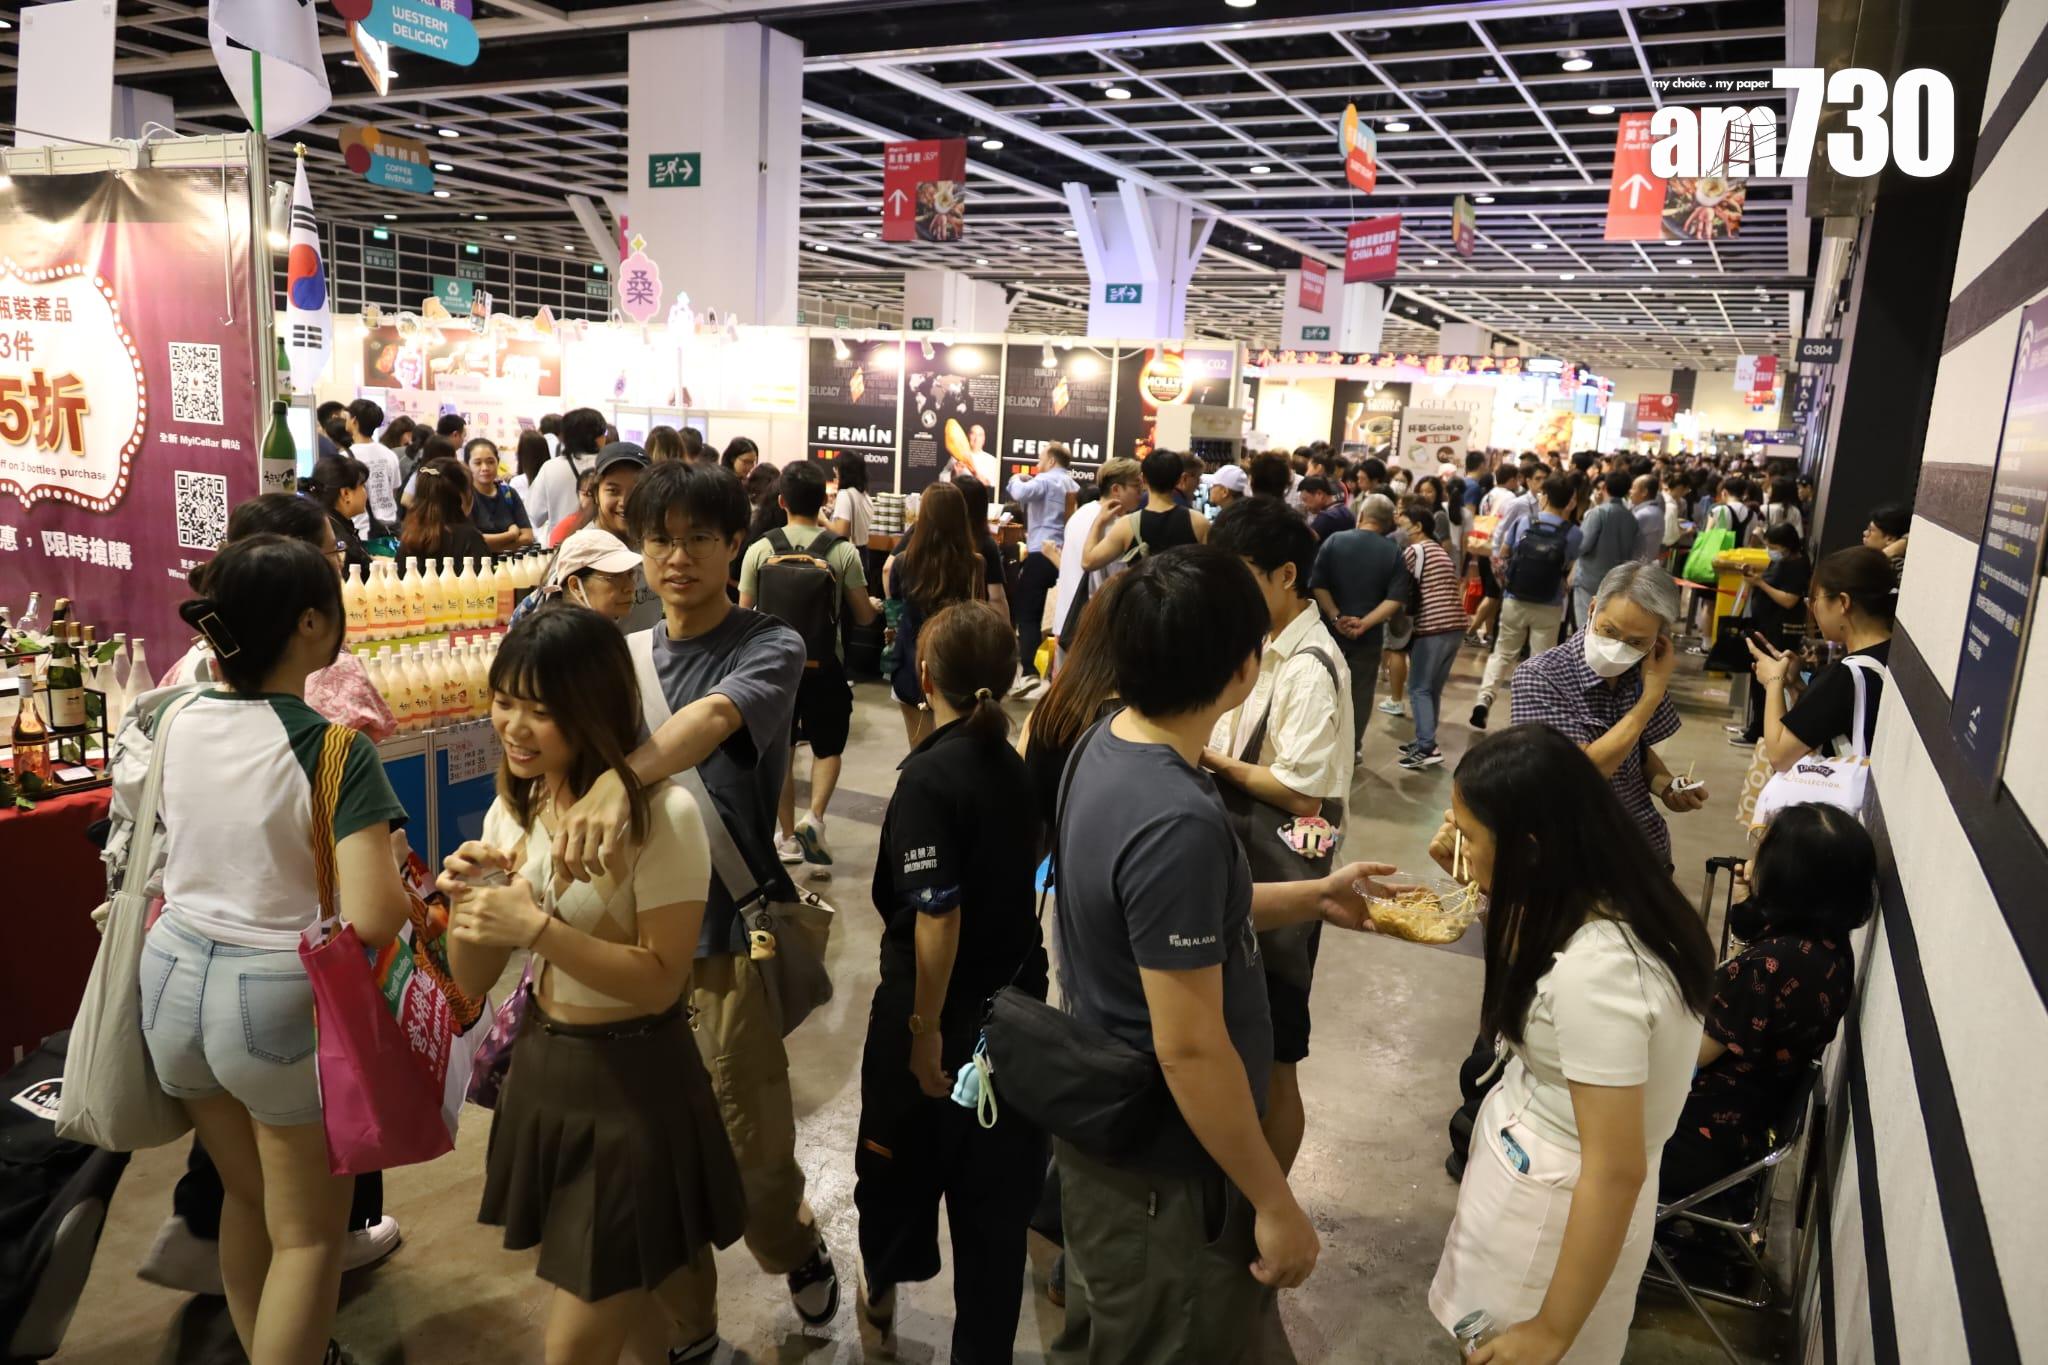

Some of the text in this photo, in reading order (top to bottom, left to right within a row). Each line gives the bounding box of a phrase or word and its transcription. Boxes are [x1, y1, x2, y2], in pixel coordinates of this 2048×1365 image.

[392, 5, 448, 33] WESTERN
[393, 23, 448, 49] DELICACY
[1352, 250, 1373, 262] CHINA
[627, 270, 653, 305] 桑
[1803, 344, 1833, 356] G304
[817, 424, 892, 444] FERMÍN
[863, 453, 889, 464] above
[27, 463, 57, 475] bottles
[60, 468, 106, 480] purchase
